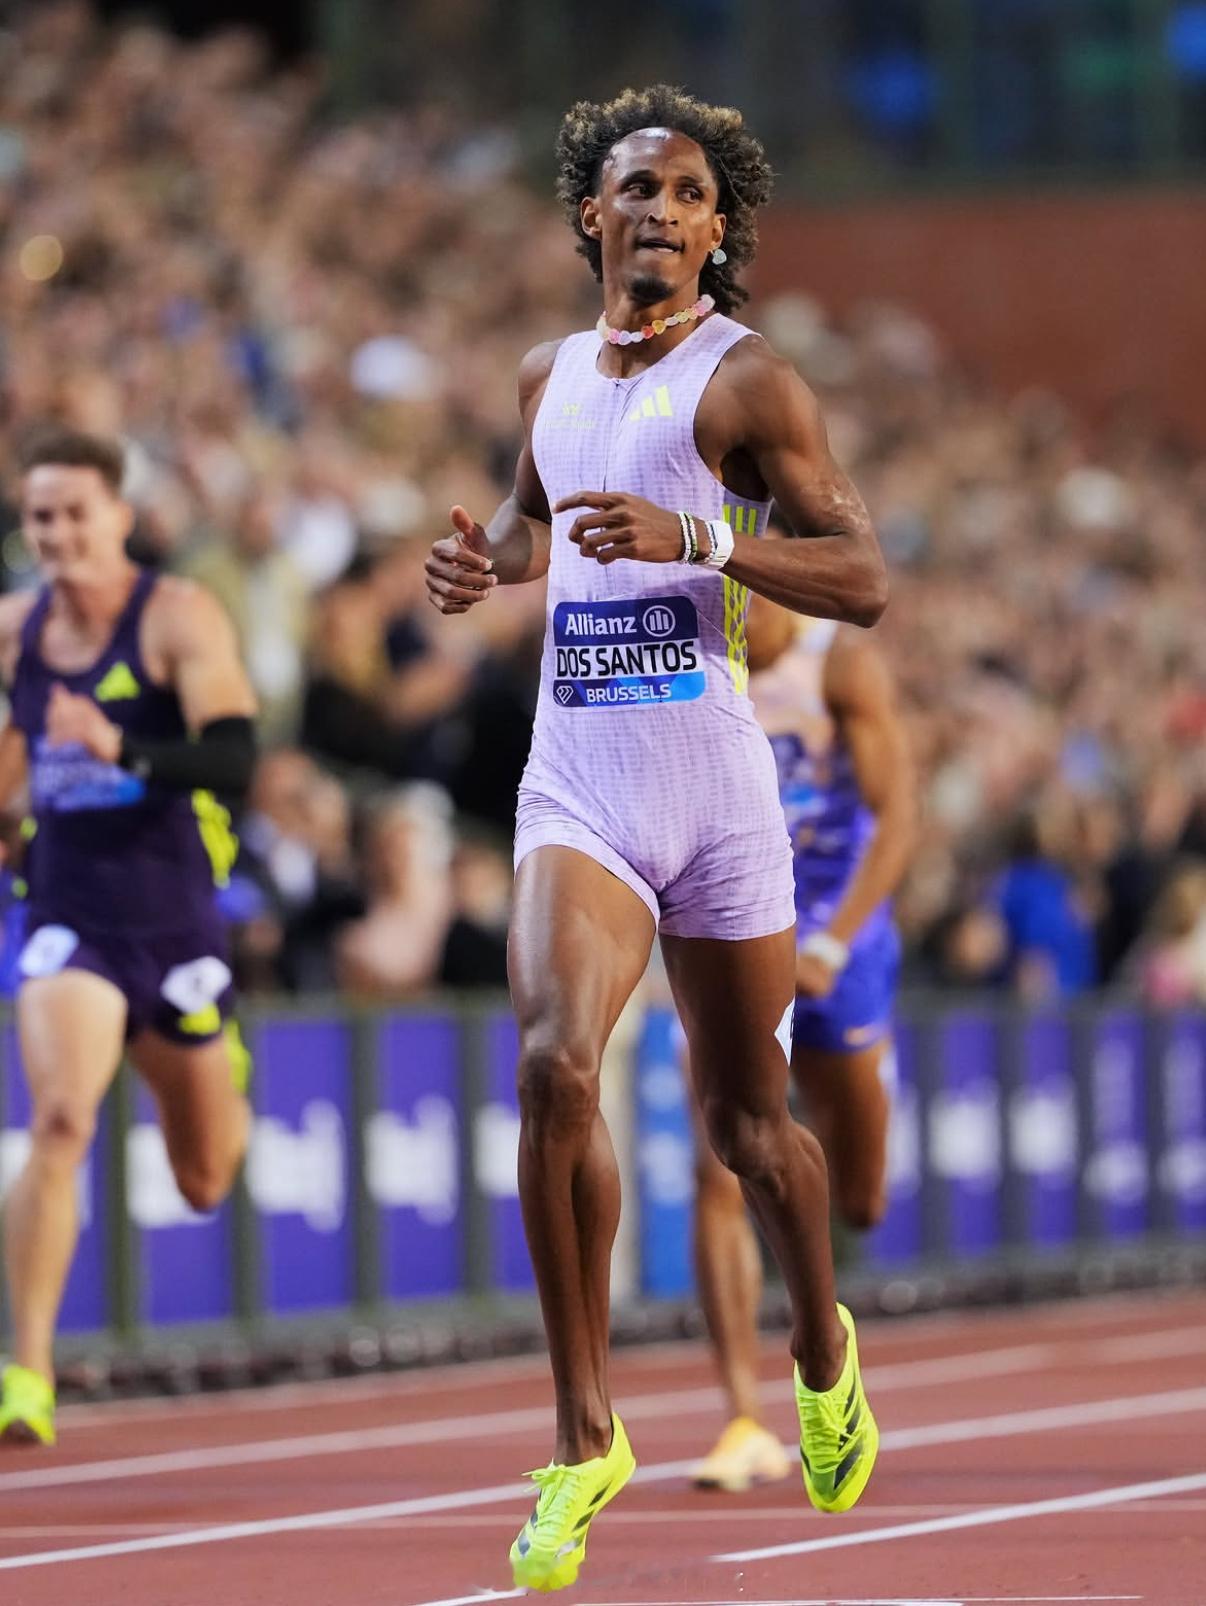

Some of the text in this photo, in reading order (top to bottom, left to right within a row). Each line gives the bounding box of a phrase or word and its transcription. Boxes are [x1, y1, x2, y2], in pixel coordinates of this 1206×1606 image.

[565, 613, 637, 636] Allianz
[556, 641, 697, 678] DOS SANTOS
[586, 684, 672, 703] BRUSSELS
